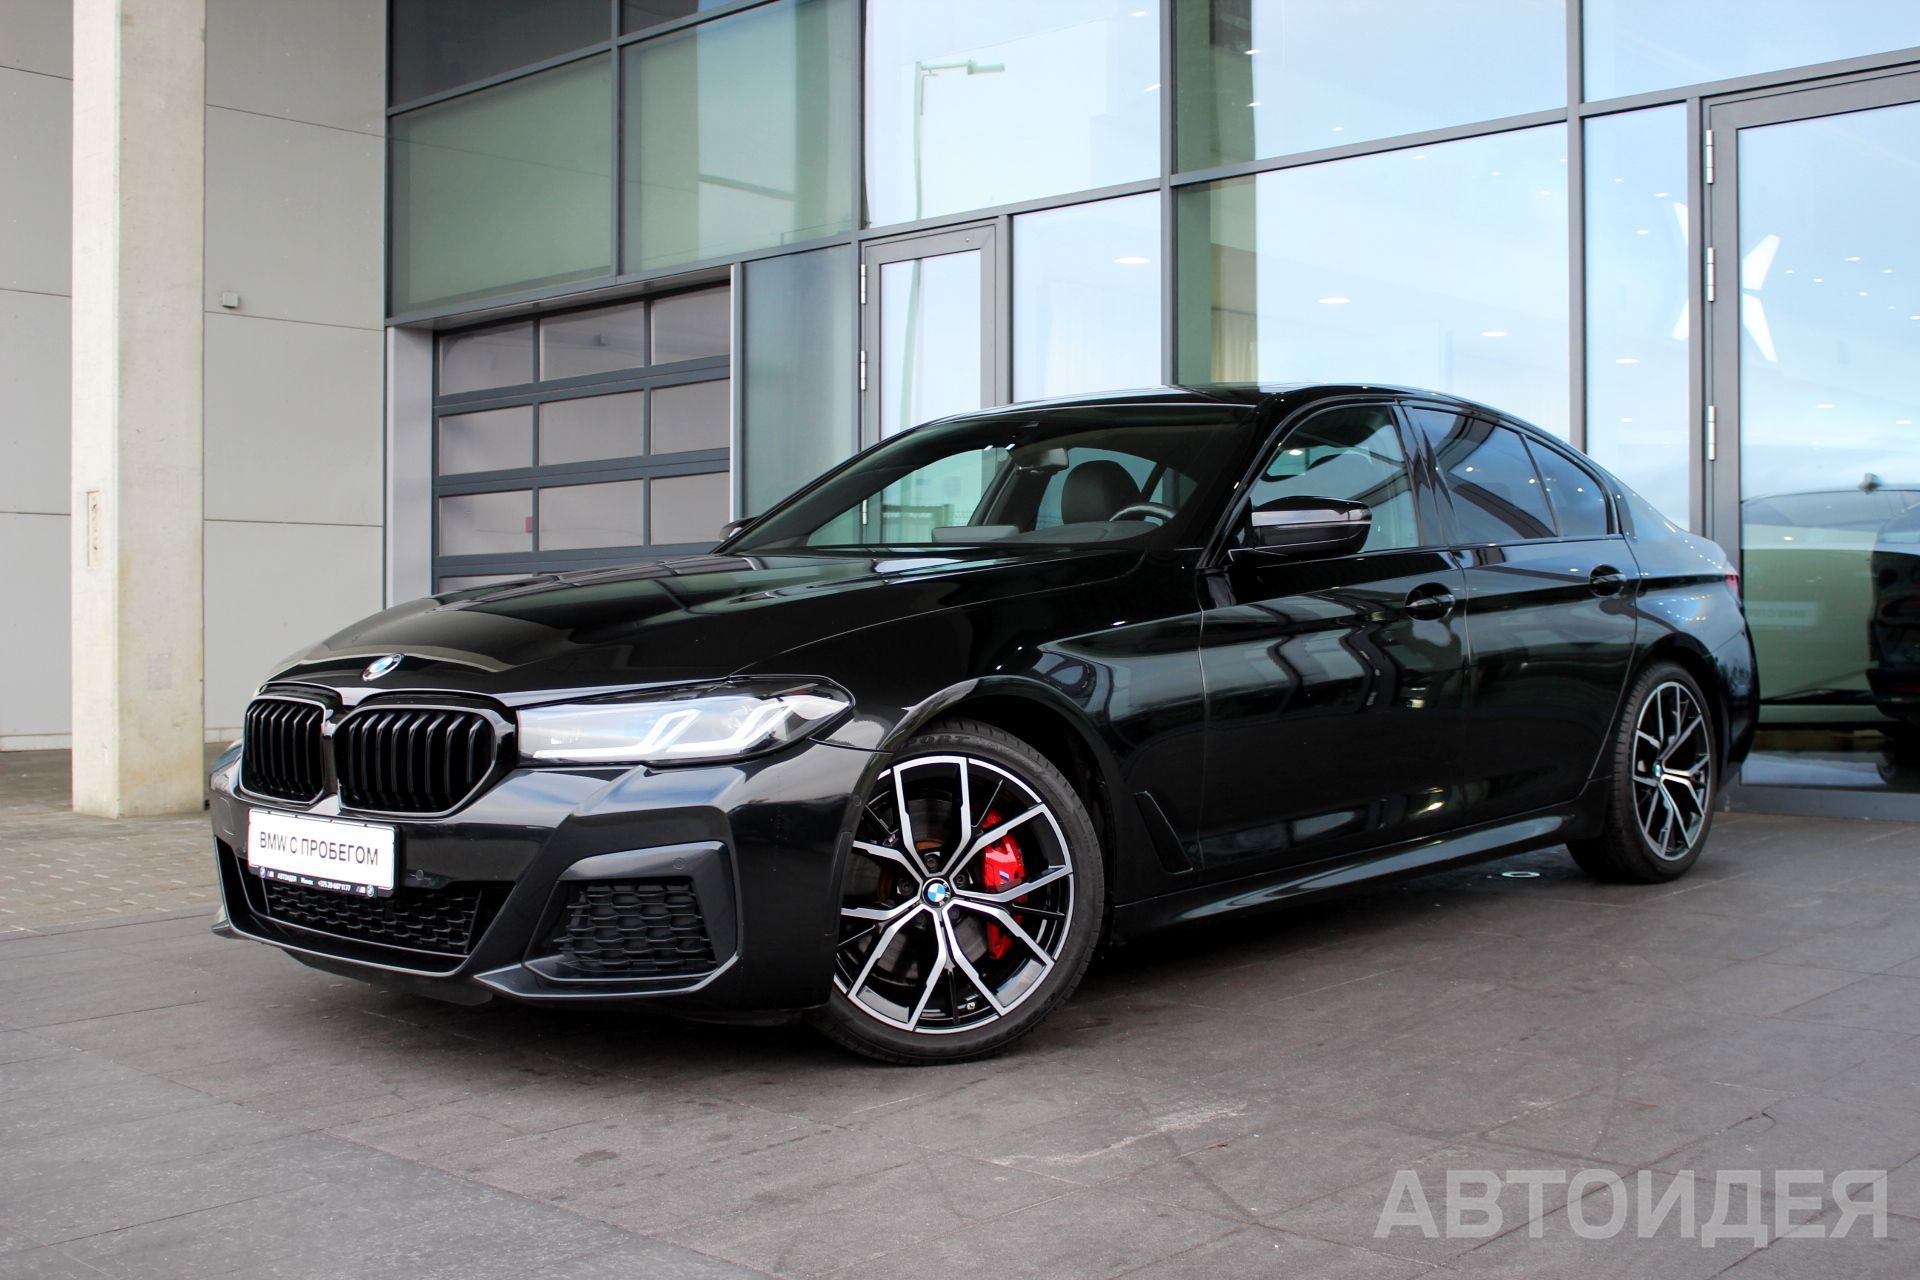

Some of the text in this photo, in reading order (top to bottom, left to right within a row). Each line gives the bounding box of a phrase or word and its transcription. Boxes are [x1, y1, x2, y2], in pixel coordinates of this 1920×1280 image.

[260, 831, 379, 866] BMW С ПРОБЕГОМ
